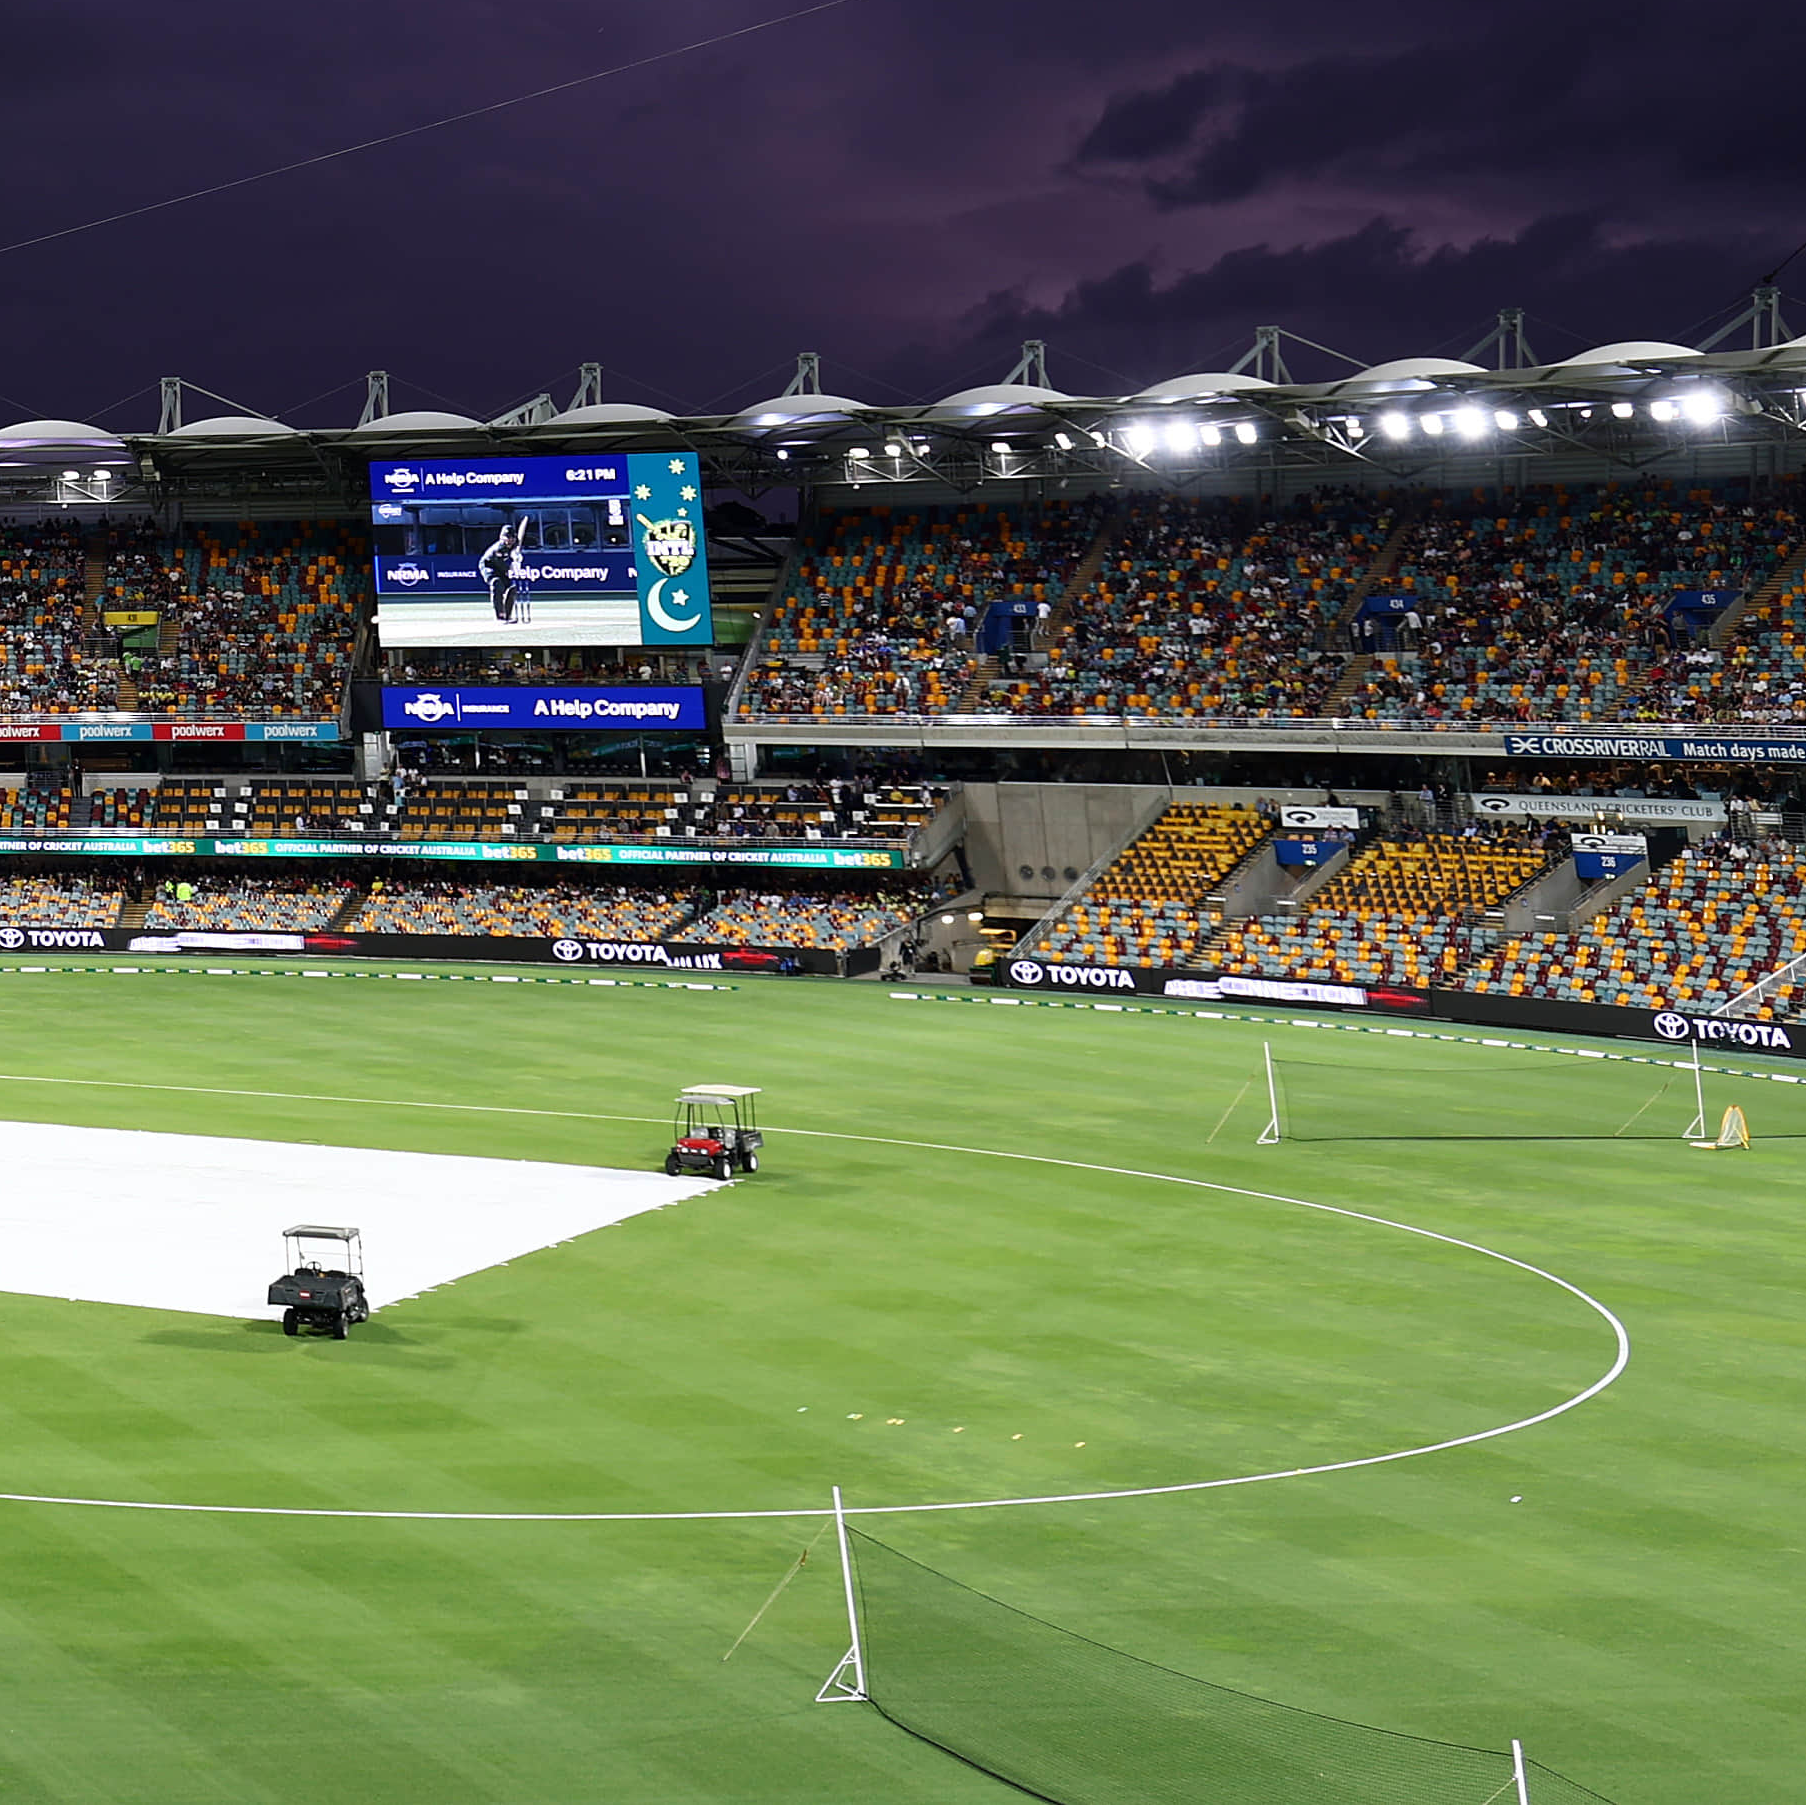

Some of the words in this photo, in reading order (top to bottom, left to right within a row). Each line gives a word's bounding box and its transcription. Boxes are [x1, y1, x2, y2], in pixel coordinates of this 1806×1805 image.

[425, 473, 435, 485] A
[436, 472, 465, 486] Help
[466, 472, 524, 486] Company
[566, 469, 594, 481] 6:21
[596, 469, 616, 481] PM
[541, 565, 608, 582] Company
[534, 703, 549, 715] A
[551, 701, 586, 718] Help
[586, 702, 680, 719] Company
[79, 724, 132, 740] poolwerx
[172, 724, 224, 740] poolwerx
[264, 724, 317, 740] poolwerx
[1683, 742, 1726, 758] Match
[1731, 743, 1764, 760] days
[1768, 744, 1806, 759] made
[1518, 799, 1600, 813] QUEENSLAND
[1682, 805, 1714, 817] CLUB
[557, 846, 612, 861] bet365
[833, 852, 891, 867] bet365
[27, 930, 105, 947] TOYOTA
[586, 941, 669, 962] TOYOTA
[1046, 964, 1135, 989] TOYOTA
[1693, 1017, 1791, 1049] TOYOTA
